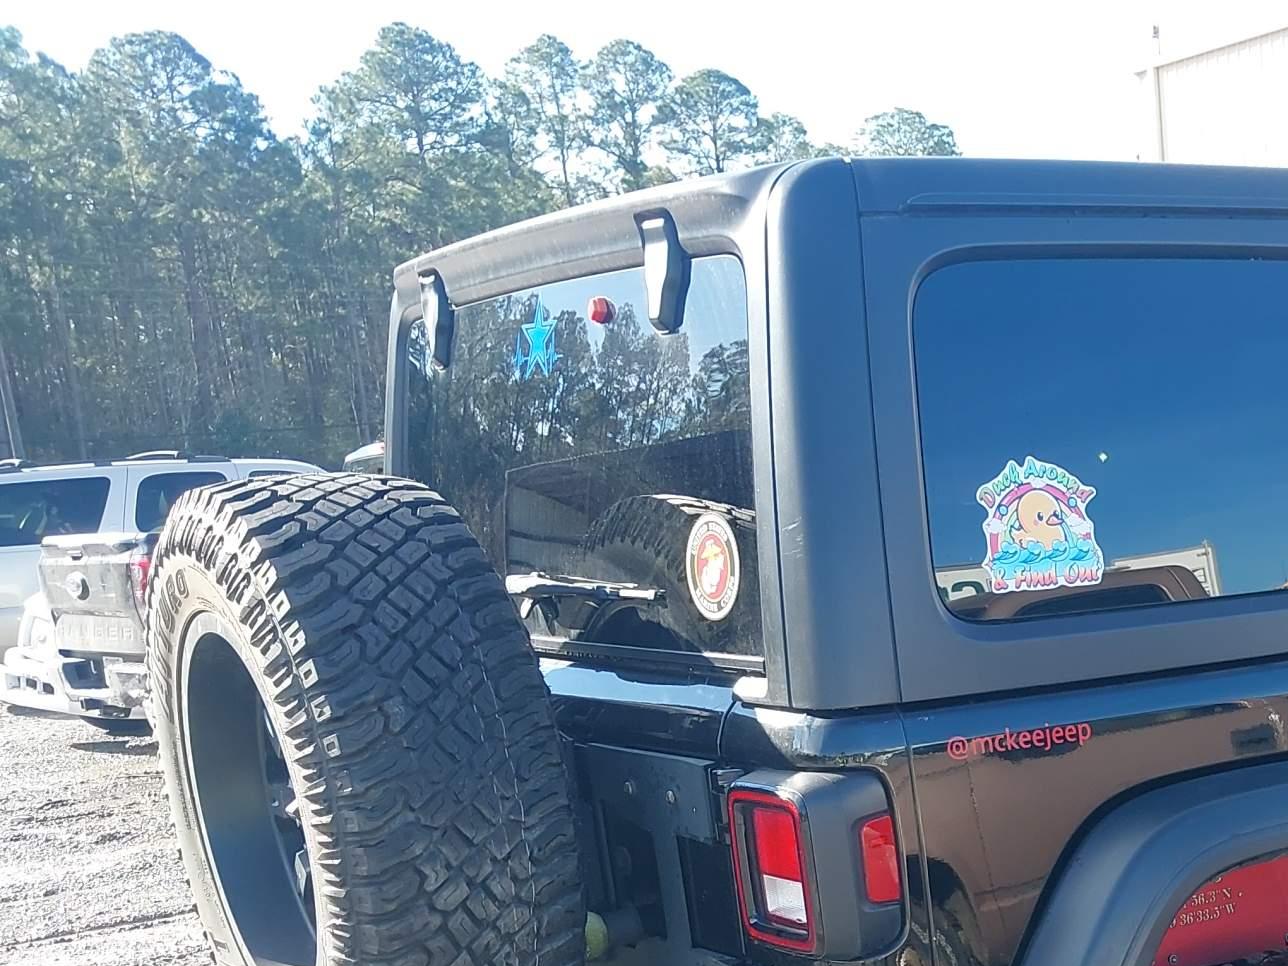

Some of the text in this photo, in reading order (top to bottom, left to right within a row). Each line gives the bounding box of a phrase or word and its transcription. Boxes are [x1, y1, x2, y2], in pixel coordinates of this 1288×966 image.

[979, 458, 1094, 508] Duck Around
[993, 567, 1009, 591] &
[1014, 564, 1059, 589] Find
[1063, 562, 1102, 585] Out
[946, 721, 1093, 760] @mckeejeep
